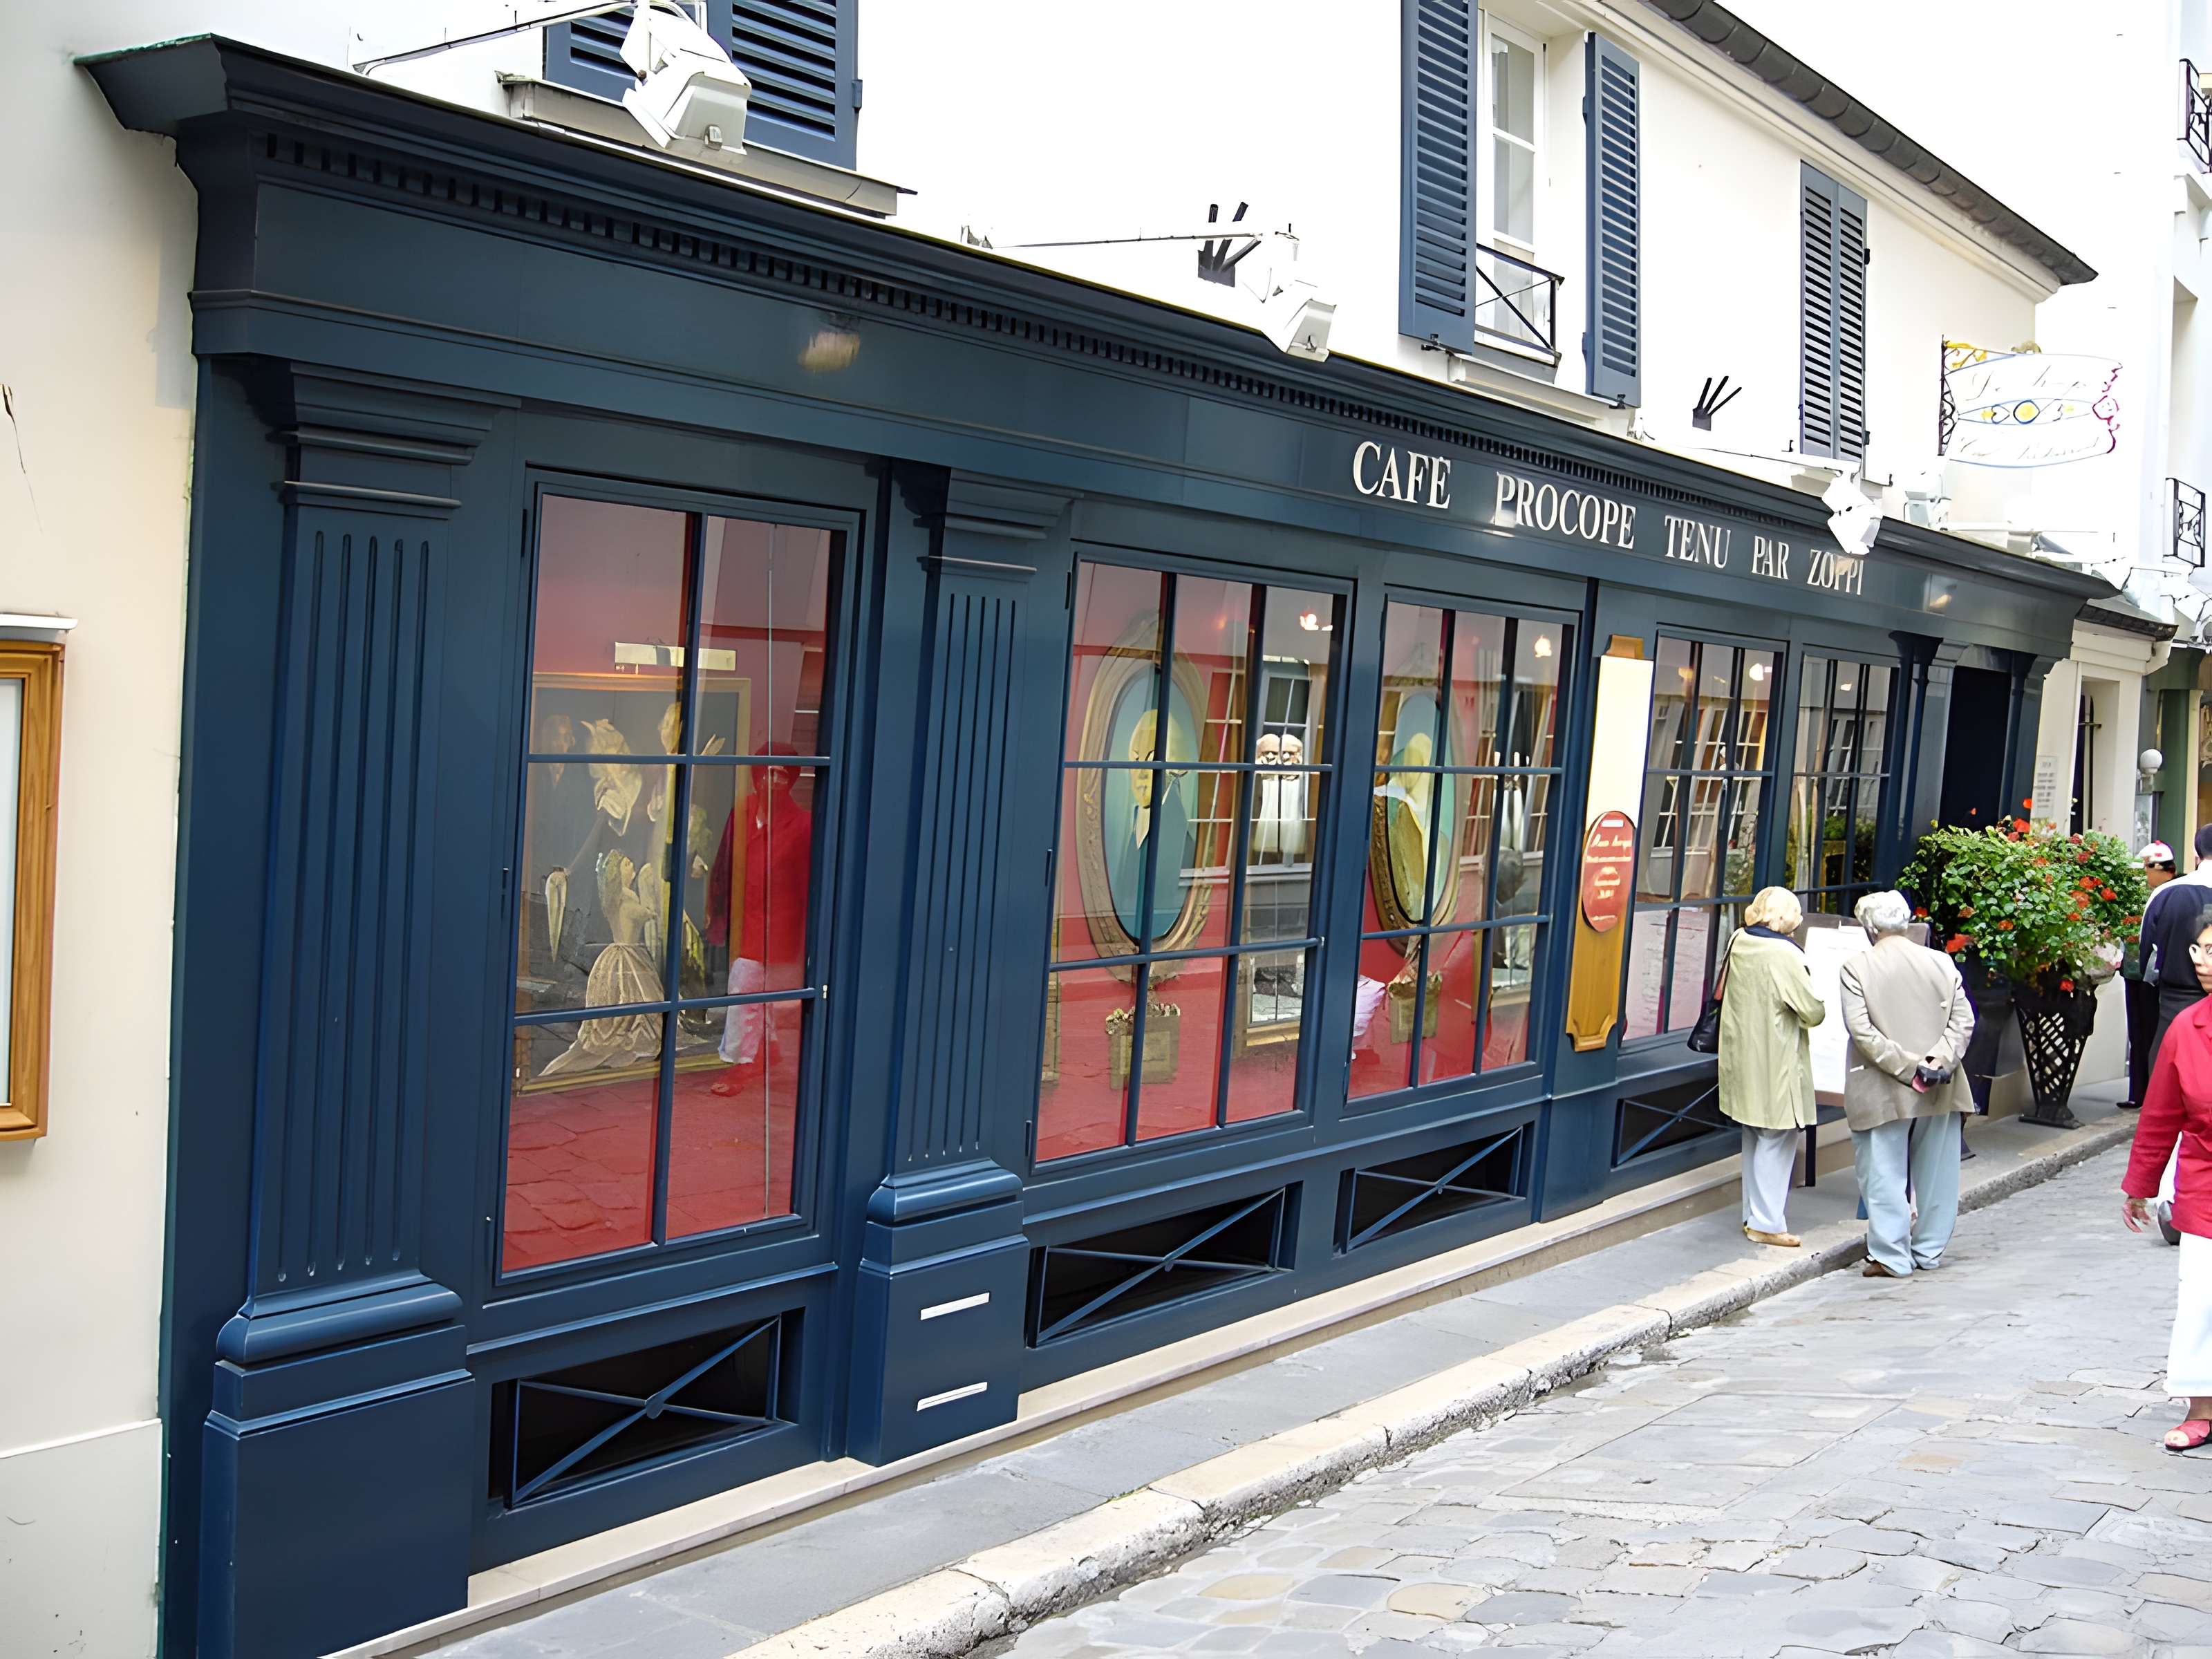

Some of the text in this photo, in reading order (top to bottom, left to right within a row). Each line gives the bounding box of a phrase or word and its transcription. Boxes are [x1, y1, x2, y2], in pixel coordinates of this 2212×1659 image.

[1490, 471, 1636, 550] PROCOPE
[1665, 515, 1731, 569] TENU
[1751, 535, 1789, 579] PAR
[1807, 549, 1864, 595] ZOPPI
